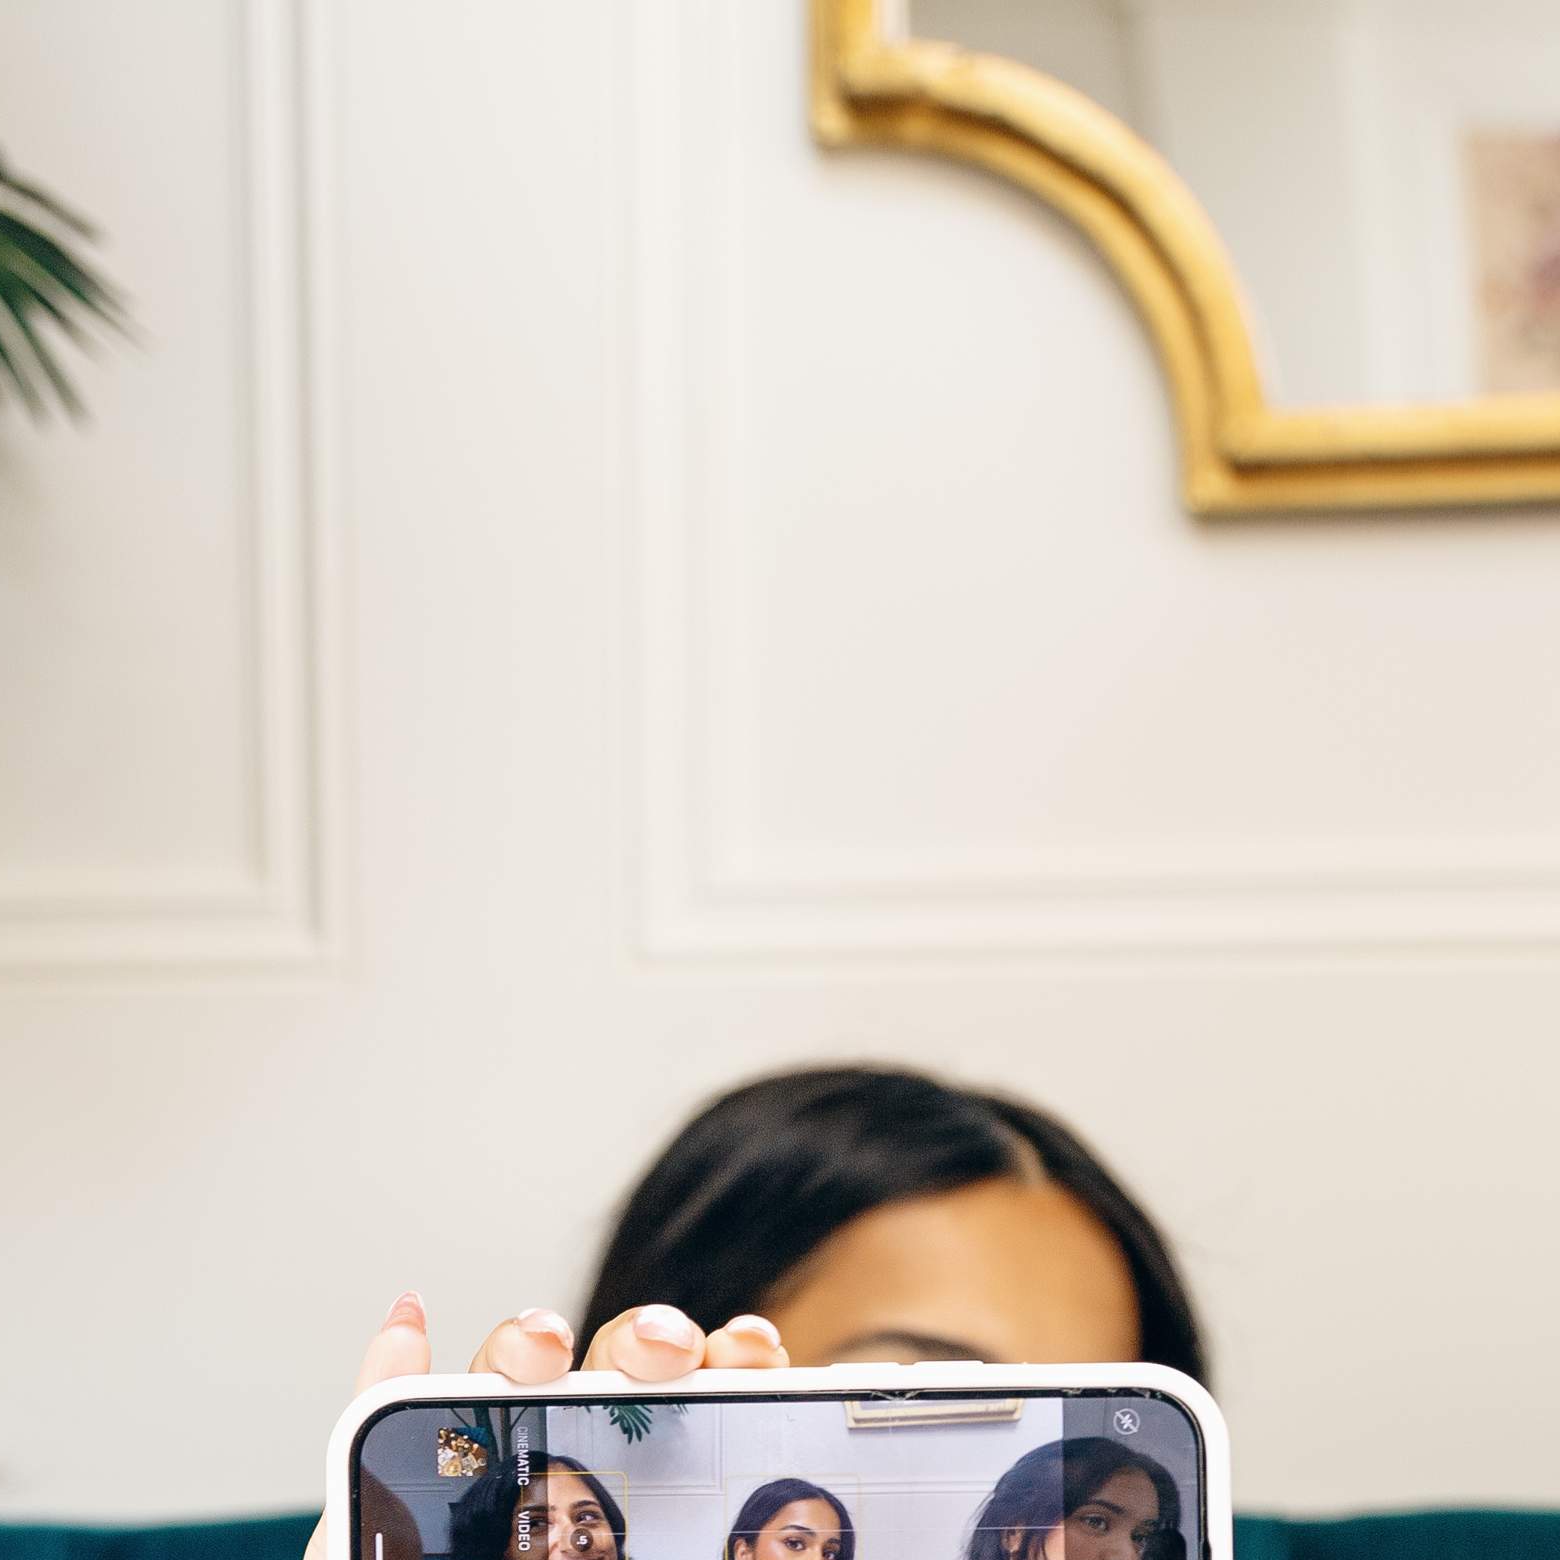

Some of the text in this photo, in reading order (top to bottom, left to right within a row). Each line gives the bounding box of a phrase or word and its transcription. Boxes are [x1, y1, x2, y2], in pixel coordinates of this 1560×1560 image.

[517, 1426, 530, 1486] CINEMATIC
[518, 1511, 531, 1551] VIDEO
[576, 1535, 588, 1546] .5
